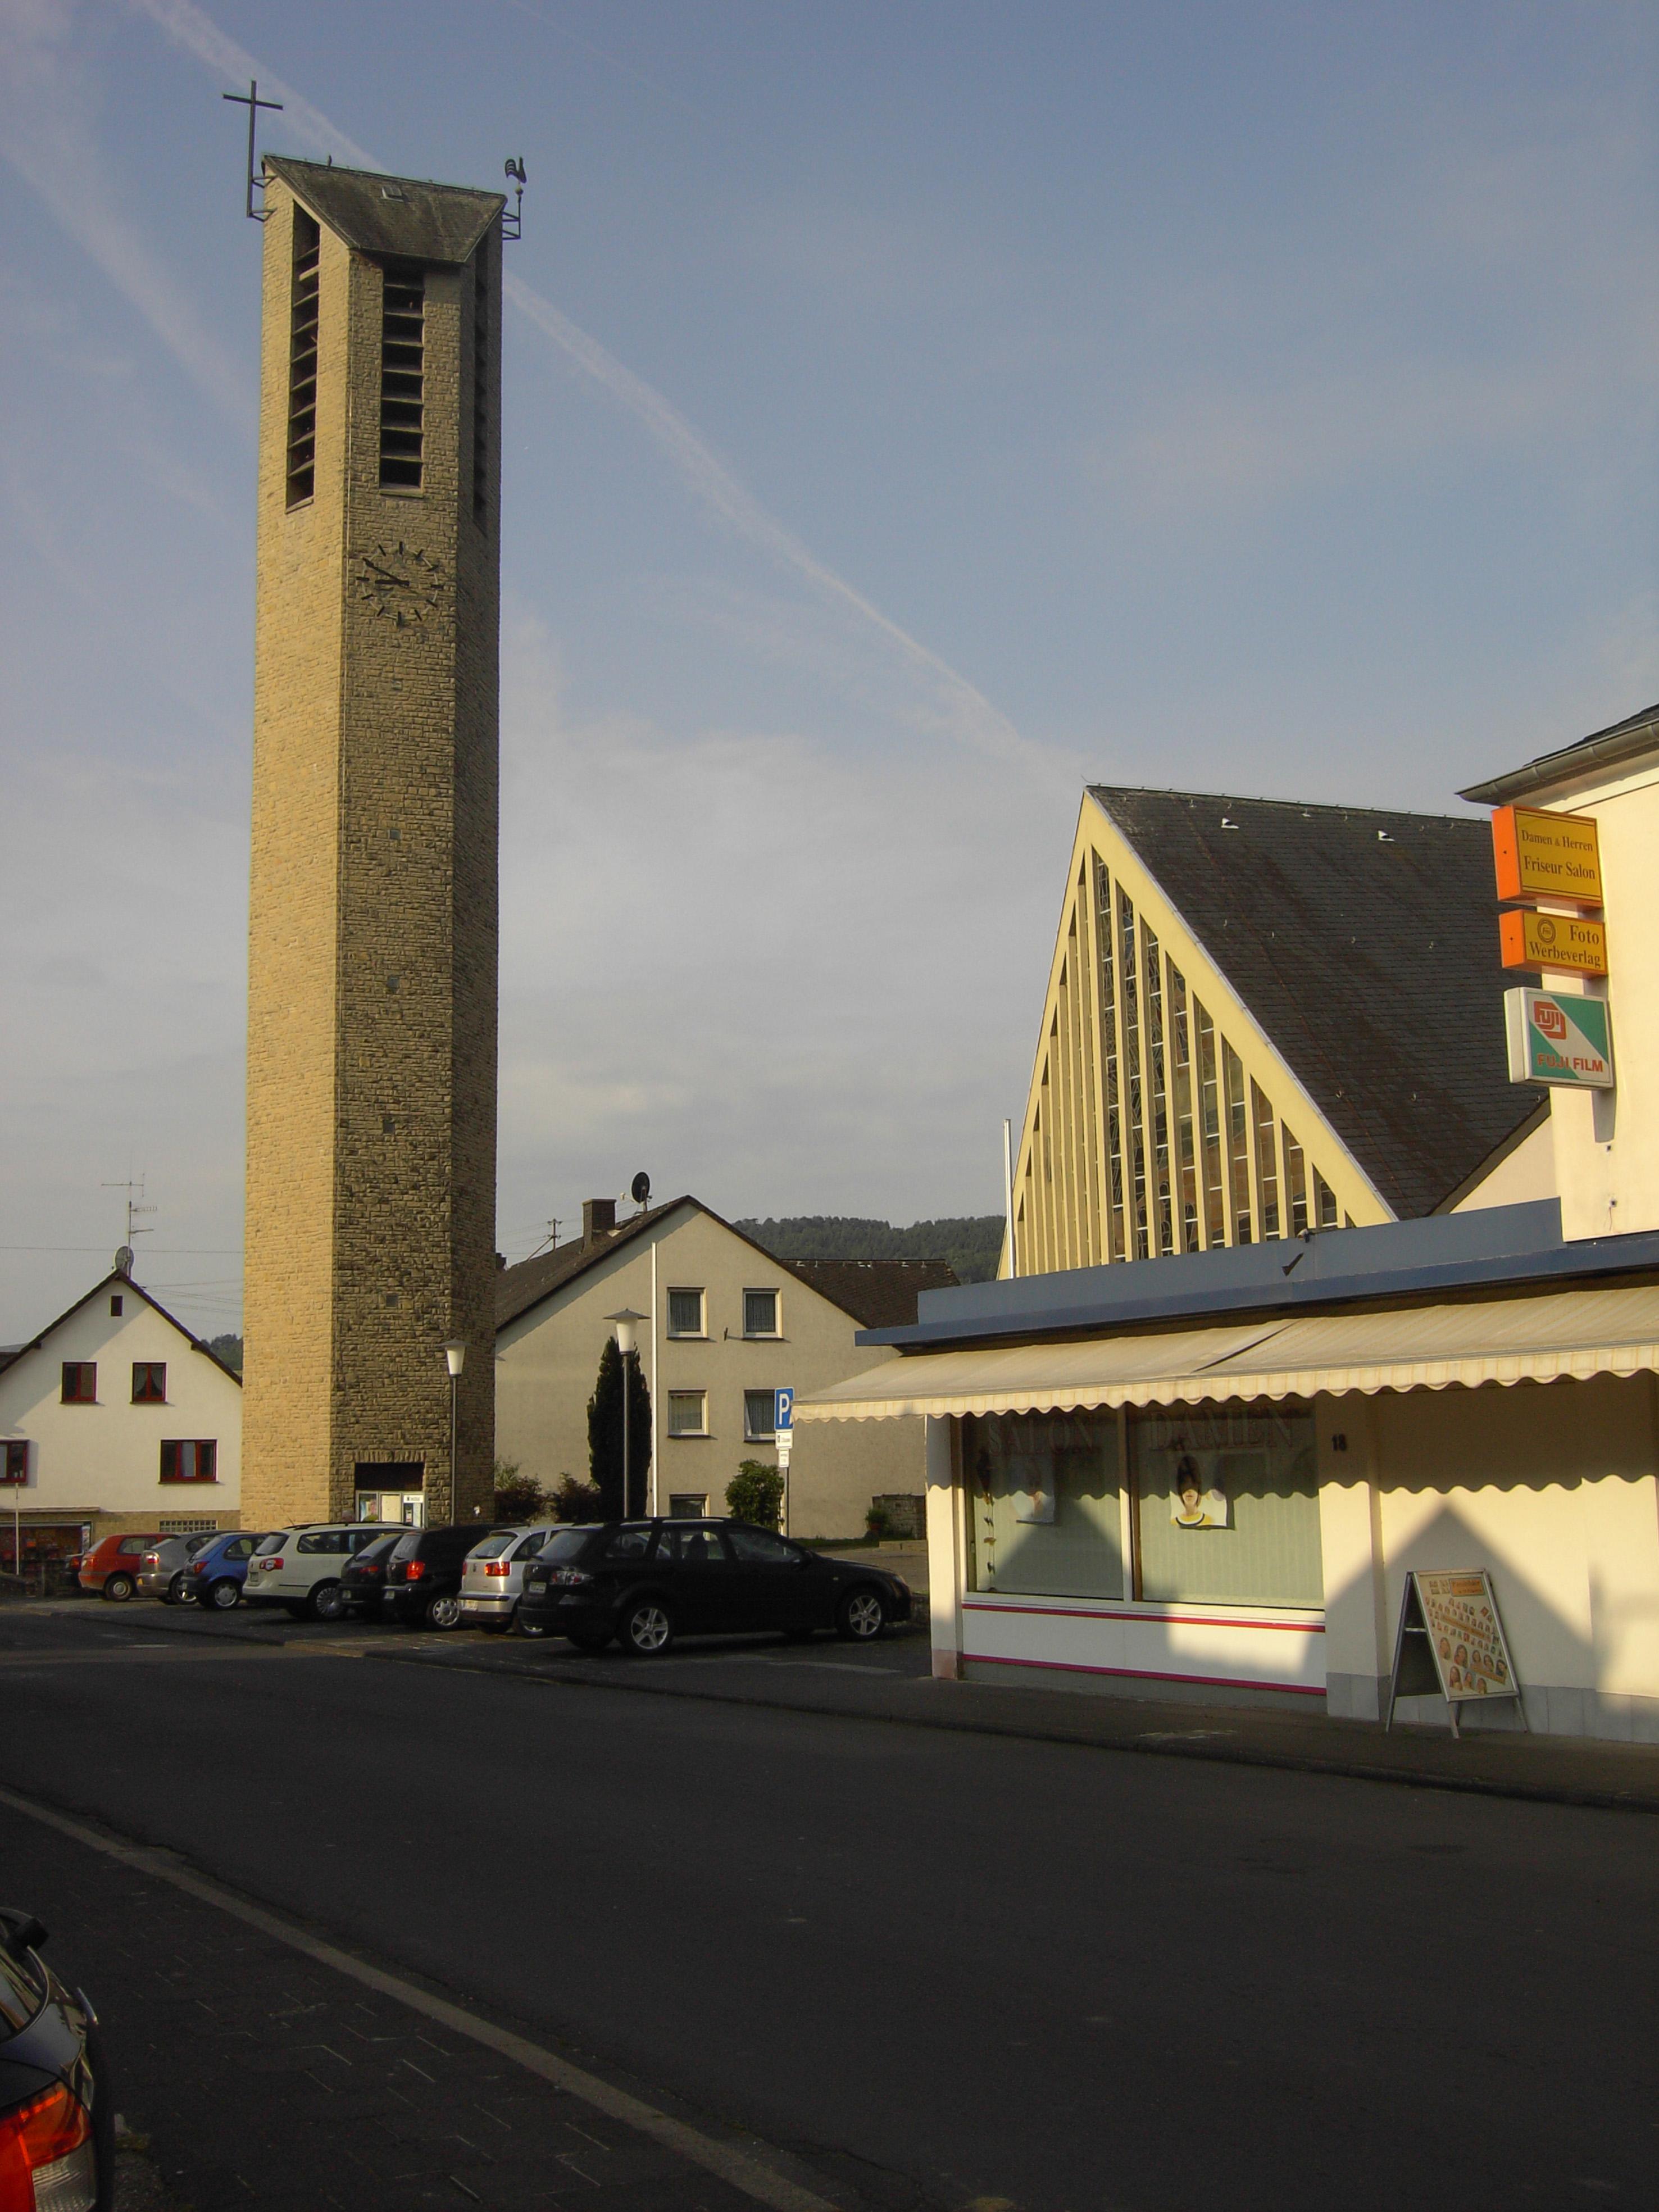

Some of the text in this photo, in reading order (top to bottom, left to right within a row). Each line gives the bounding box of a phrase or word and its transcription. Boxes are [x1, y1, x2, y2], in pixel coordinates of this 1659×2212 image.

[1522, 830, 1552, 845] Damen
[1562, 836, 1593, 851] Herren
[1524, 855, 1595, 879] Friseur Salon
[1570, 925, 1599, 944] Foto
[1529, 942, 1601, 969] Werbeverlag
[1537, 1053, 1603, 1072] FUJI FILM
[779, 1393, 790, 1425] P
[988, 1402, 1293, 1456] SALON DAMEN
